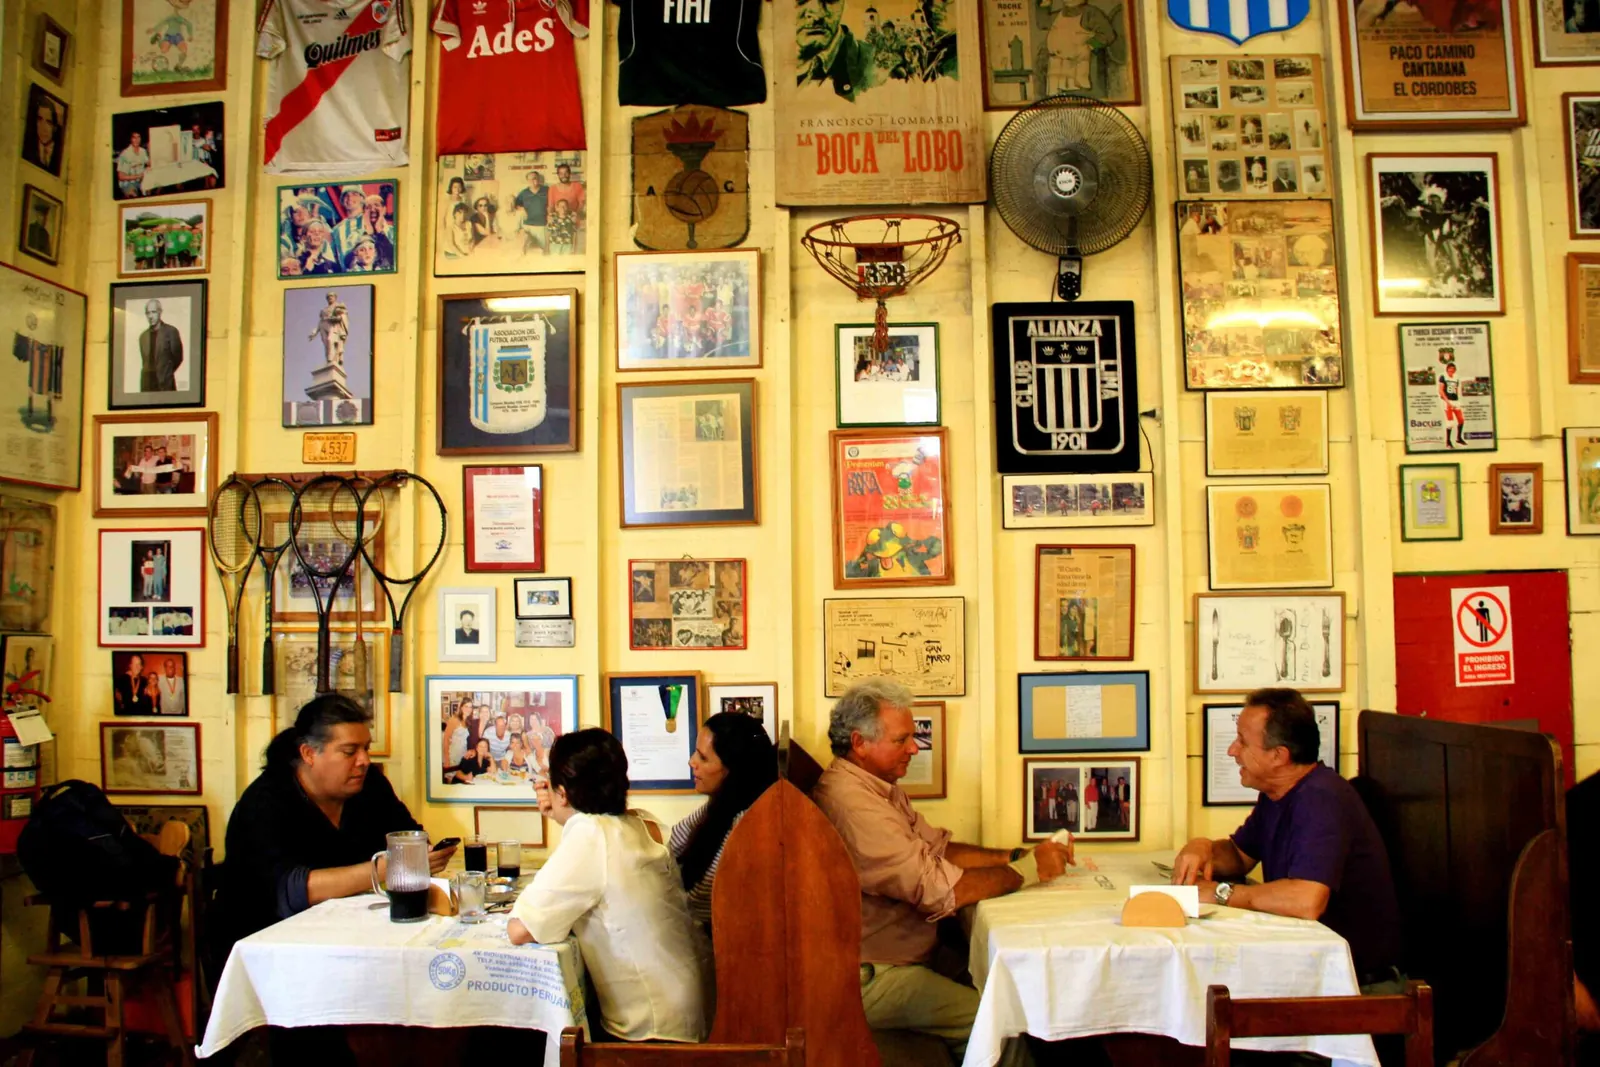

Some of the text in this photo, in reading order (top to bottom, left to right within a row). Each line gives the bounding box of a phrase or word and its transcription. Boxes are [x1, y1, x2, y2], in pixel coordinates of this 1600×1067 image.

[466, 17, 555, 58] AdeS
[304, 29, 382, 68] Quilmes
[1390, 44, 1475, 60] PACO CAMINO
[1394, 81, 1477, 96] EL CORDOBES
[800, 117, 874, 128] FRANCISCO
[891, 115, 960, 126] LOMBARDI
[797, 129, 964, 175] LA BOCA DEL LOBO
[1026, 319, 1103, 337] ALIANZA
[510, 335, 540, 343] ARGENTINO
[1015, 360, 1033, 408] CLUB
[1100, 359, 1119, 400] LIMA
[1051, 432, 1087, 450] 1901
[1464, 655, 1505, 663] PROHIBIDO
[1474, 662, 1507, 671] INGRESO
[467, 980, 529, 996] PRODUCTO
